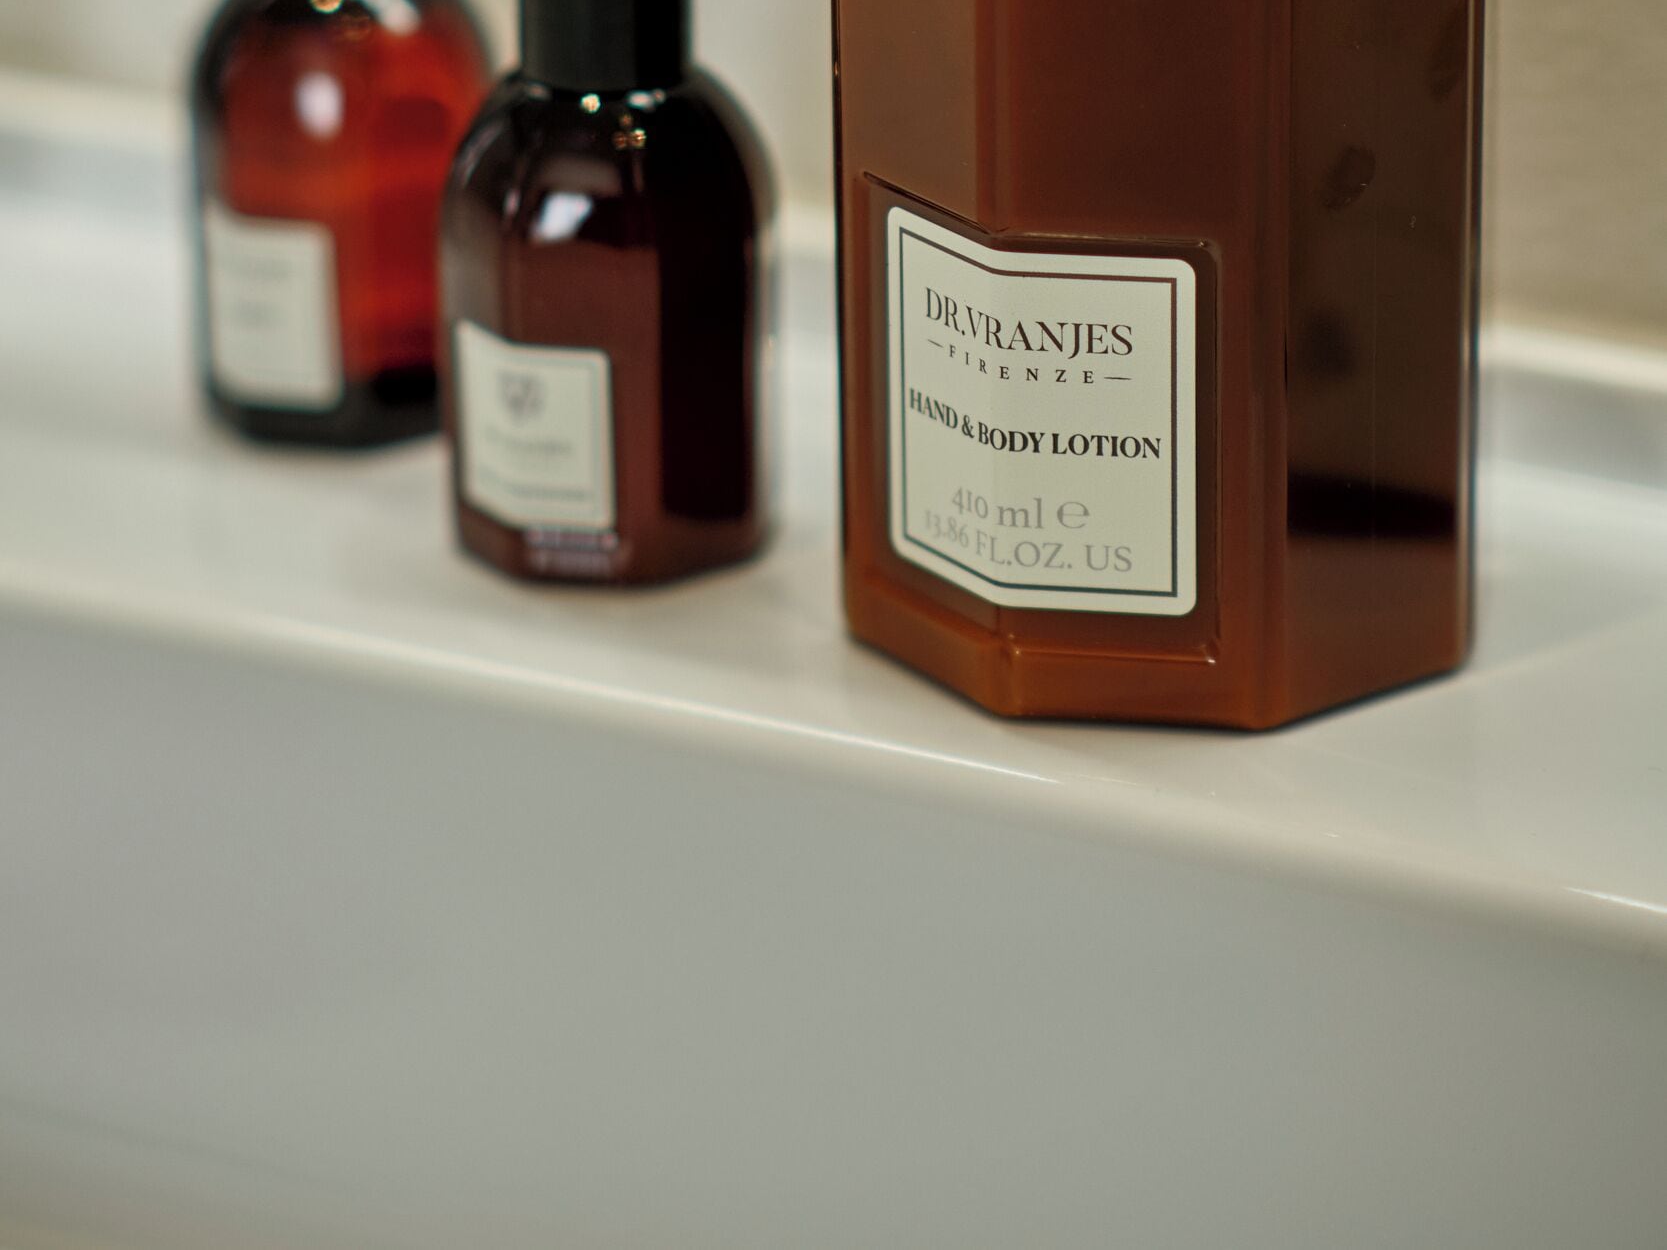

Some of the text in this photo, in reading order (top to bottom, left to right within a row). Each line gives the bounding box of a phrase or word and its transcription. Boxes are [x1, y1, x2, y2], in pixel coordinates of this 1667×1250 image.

[949, 344, 1094, 384] FIRENZE
[909, 388, 1161, 459] HAND & BODY LOTION
[951, 487, 988, 519] 410
[996, 498, 1044, 530] ml
[1085, 544, 1133, 572] US
